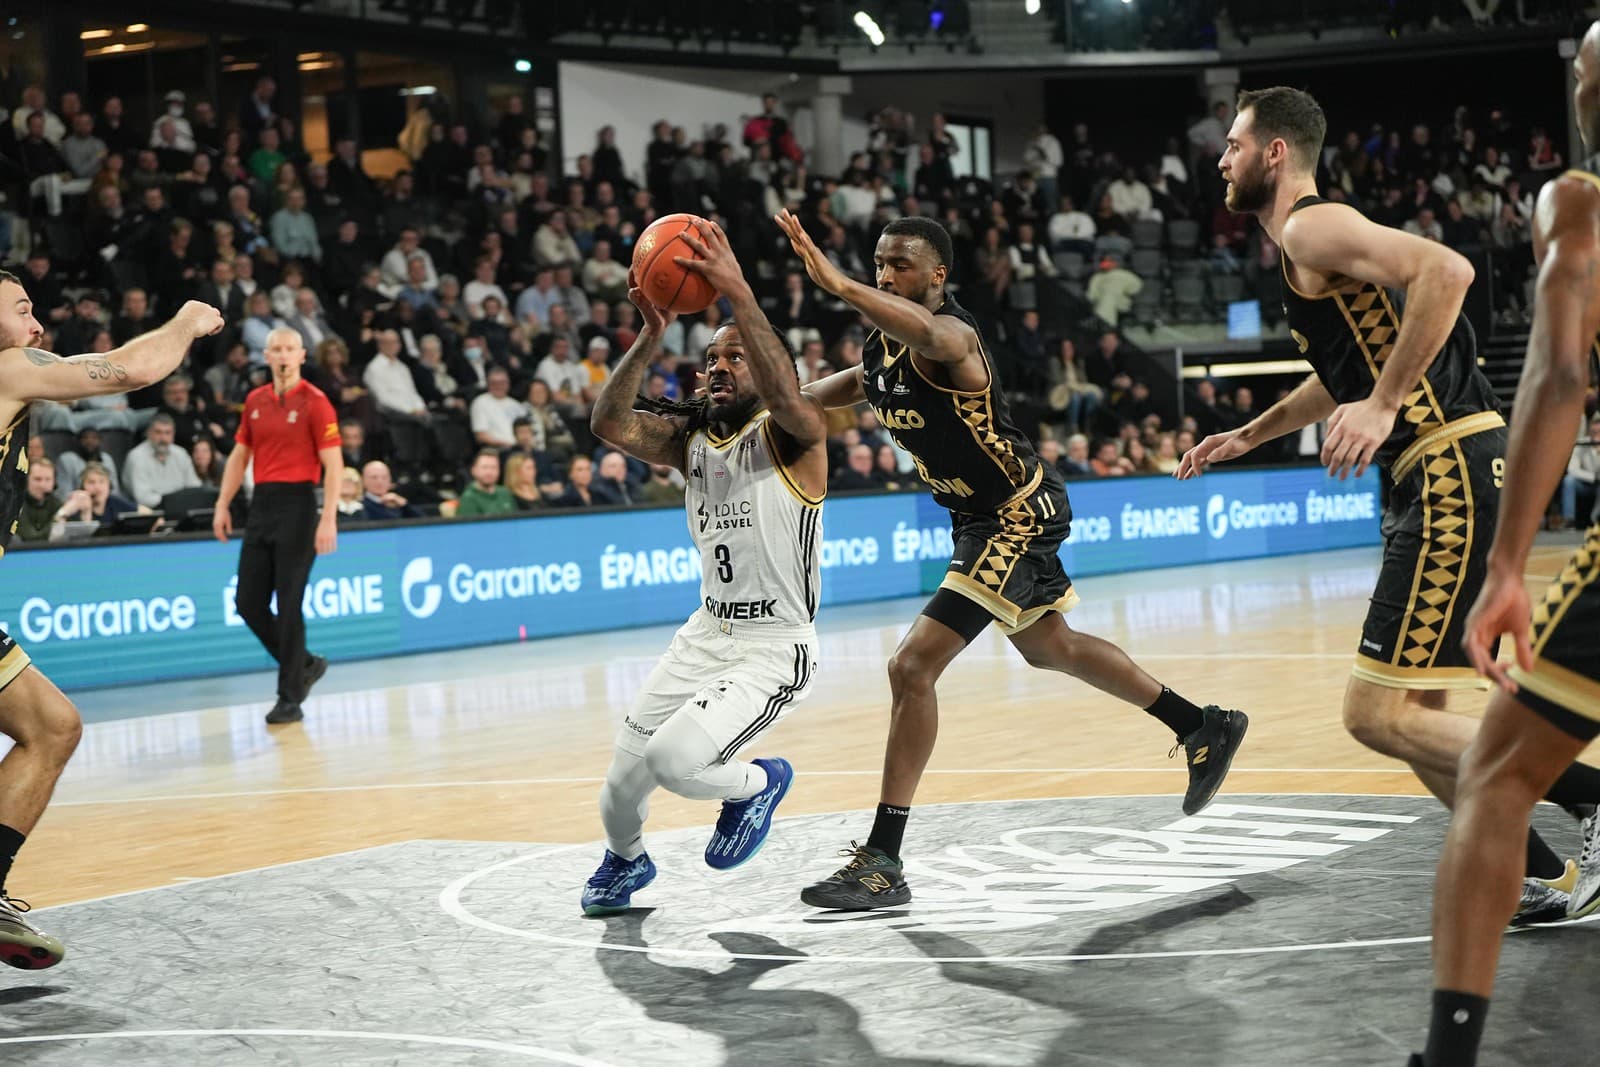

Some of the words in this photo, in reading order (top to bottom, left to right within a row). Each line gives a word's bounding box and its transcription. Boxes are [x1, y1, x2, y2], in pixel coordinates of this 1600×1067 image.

[715, 501, 751, 518] LDLC
[715, 517, 752, 530] ASVEL
[1037, 492, 1056, 519] 11
[1121, 503, 1200, 539] ÉPARGNE
[1229, 500, 1298, 529] Garance
[1306, 489, 1375, 524] ÉPARGNE
[714, 544, 733, 583] 3
[821, 535, 879, 567] ance
[892, 521, 952, 562] ÉPAR
[449, 561, 582, 603] Garance
[600, 544, 703, 590] ÉPARGN
[19, 594, 197, 644] Garance
